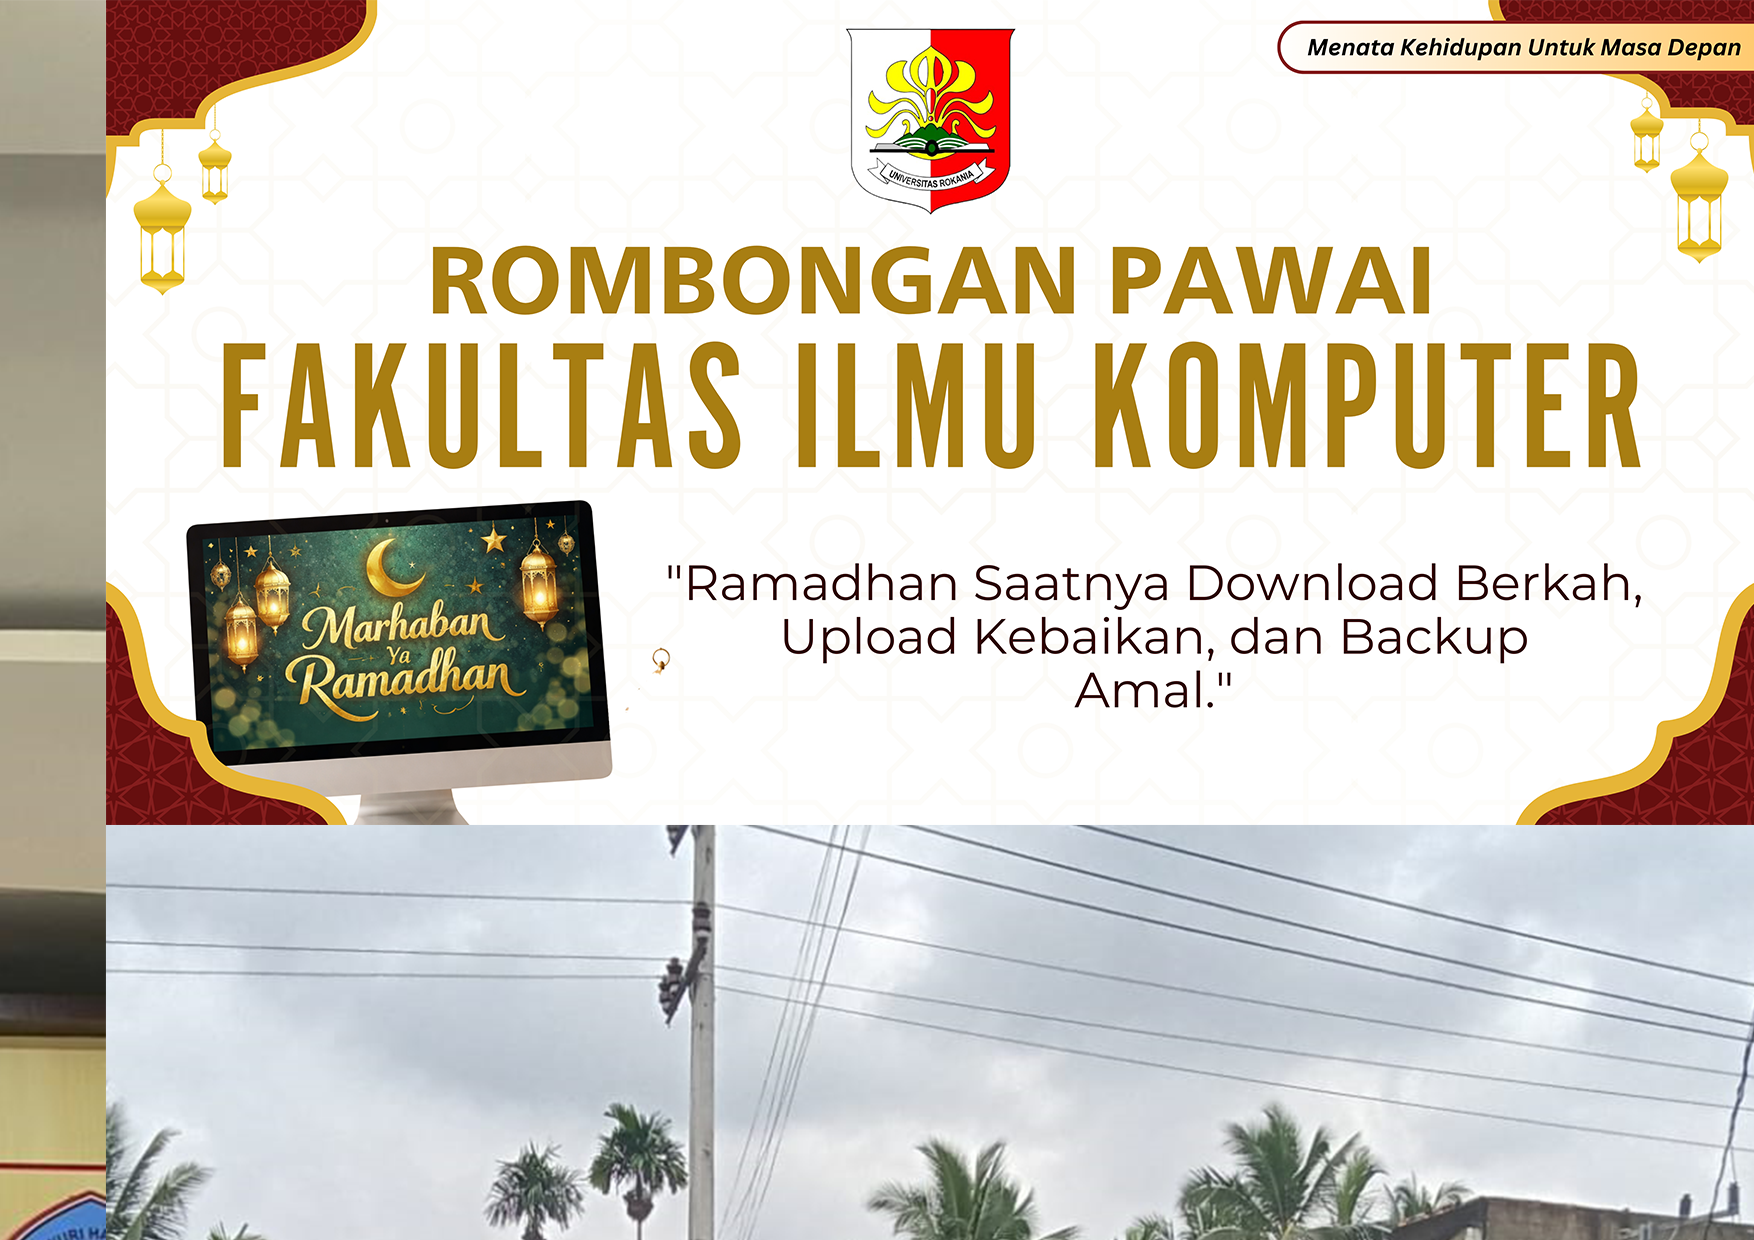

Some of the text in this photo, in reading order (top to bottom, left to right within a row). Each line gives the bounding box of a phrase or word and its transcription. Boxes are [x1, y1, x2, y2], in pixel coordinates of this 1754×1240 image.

[1307, 36, 1742, 61] Menata Kehidupan Untuk Masa Depan
[889, 169, 974, 188] UNIVERSITAS ROKANIA
[432, 245, 1430, 316] ROMBONGAN PAWAI
[223, 341, 1641, 470] FAKULTAS ILMU KOMPUTER
[667, 562, 1642, 611] "Ramadhan Saatnya Download Berkah,
[301, 598, 506, 650] Marhaban
[783, 616, 1528, 664] Upload Kebaikan, dan Backup
[386, 646, 411, 666] Ya
[285, 646, 527, 722] Ramadhan
[1074, 670, 1231, 709] Amal."
